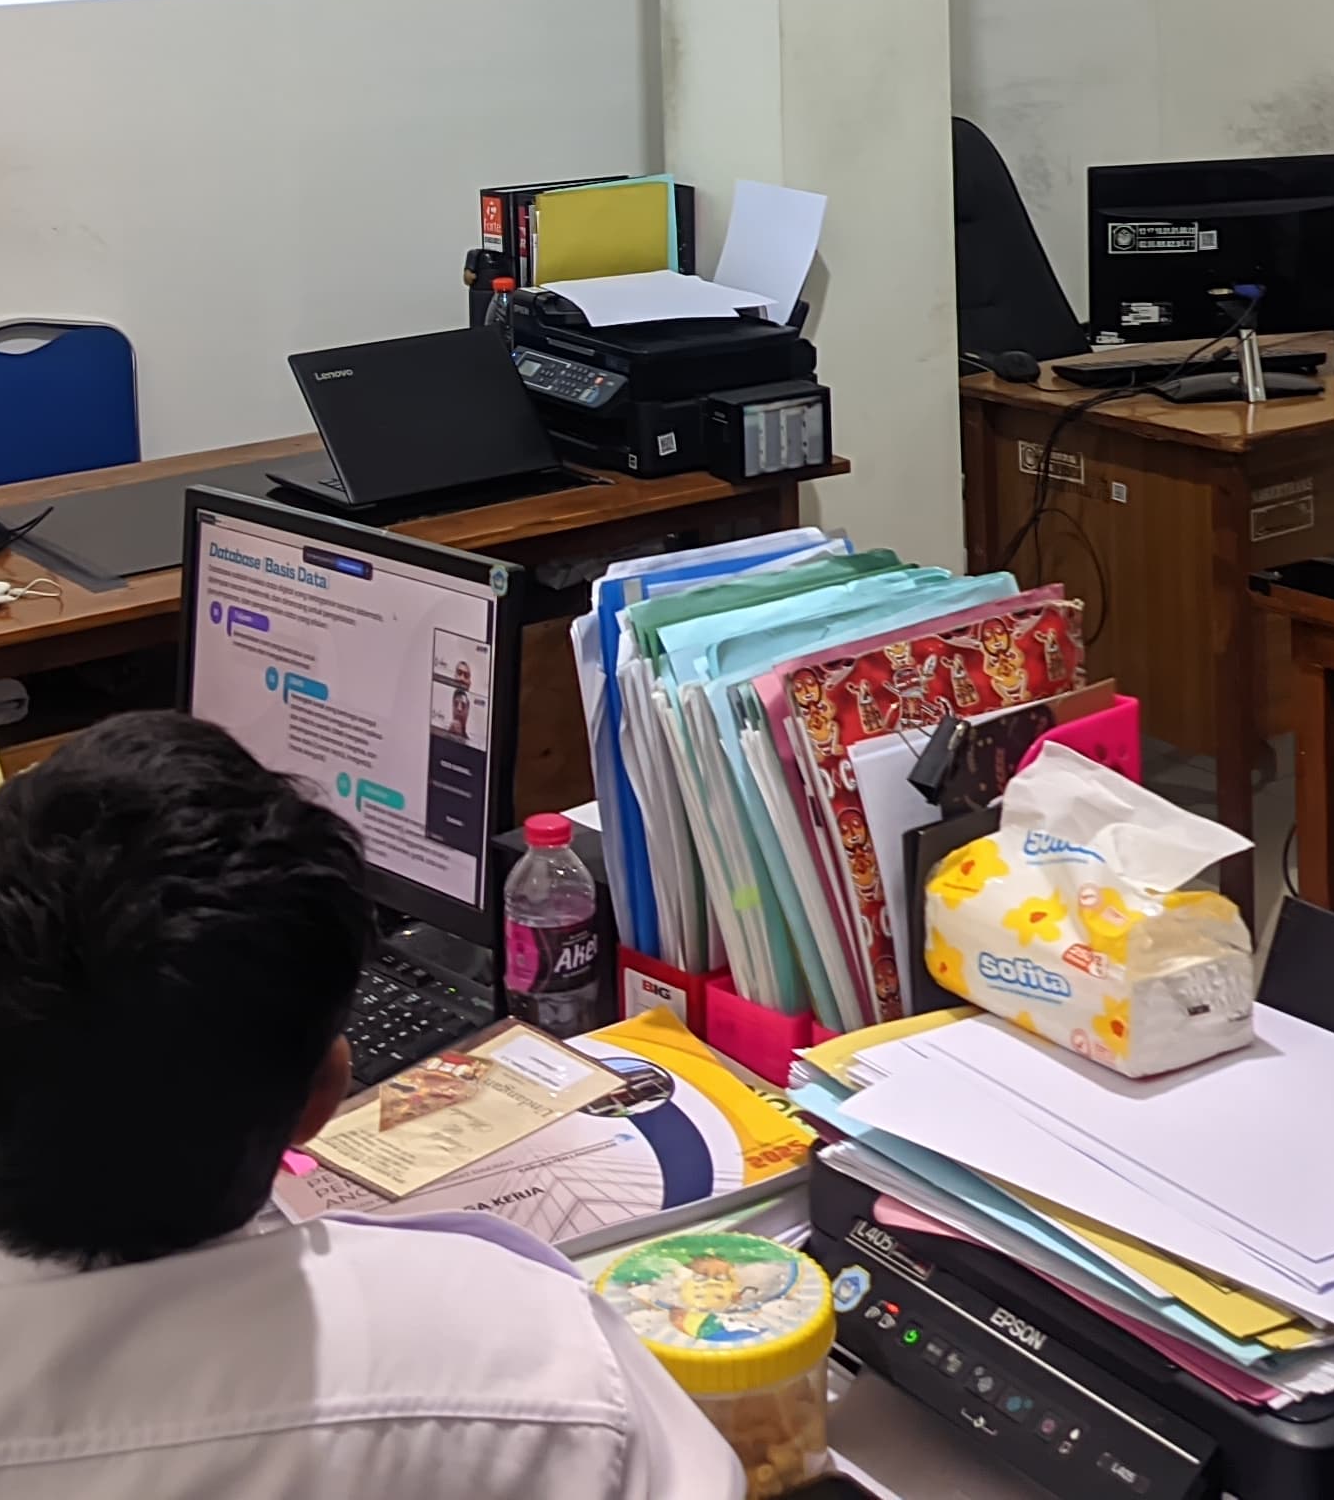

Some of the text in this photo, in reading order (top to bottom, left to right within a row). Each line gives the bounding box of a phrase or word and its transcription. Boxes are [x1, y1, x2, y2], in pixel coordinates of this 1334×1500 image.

[314, 368, 354, 381] Lenovo
[209, 542, 261, 570] Database
[642, 979, 672, 1000] BIG
[978, 952, 1072, 998] sofita
[855, 1222, 895, 1252] L405
[989, 1306, 1048, 1351] EPSON
